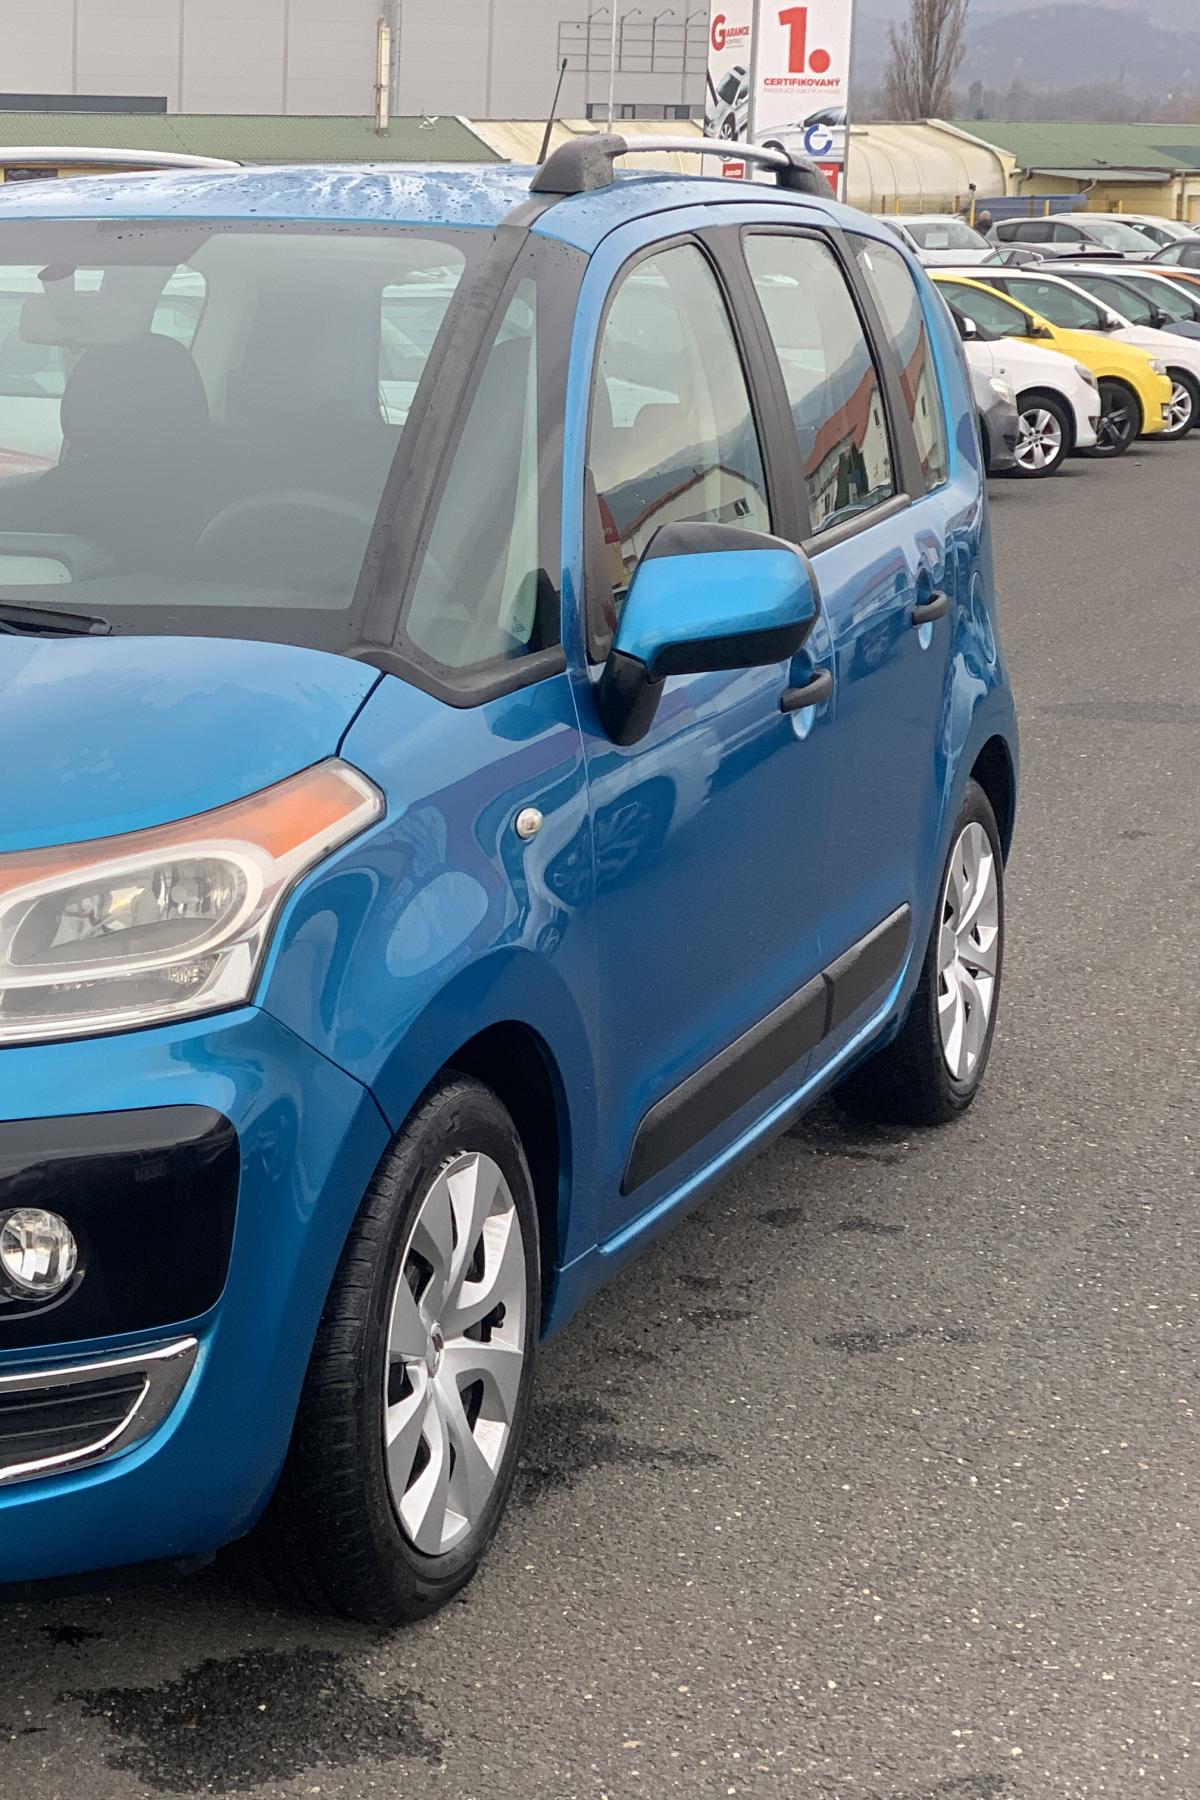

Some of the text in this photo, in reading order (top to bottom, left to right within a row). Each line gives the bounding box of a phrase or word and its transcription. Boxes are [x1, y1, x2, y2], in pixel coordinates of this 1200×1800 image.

[711, 14, 750, 51] GARANCE
[778, 7, 831, 74] 1.
[763, 77, 840, 87] CERTIFIKOVANÝ
